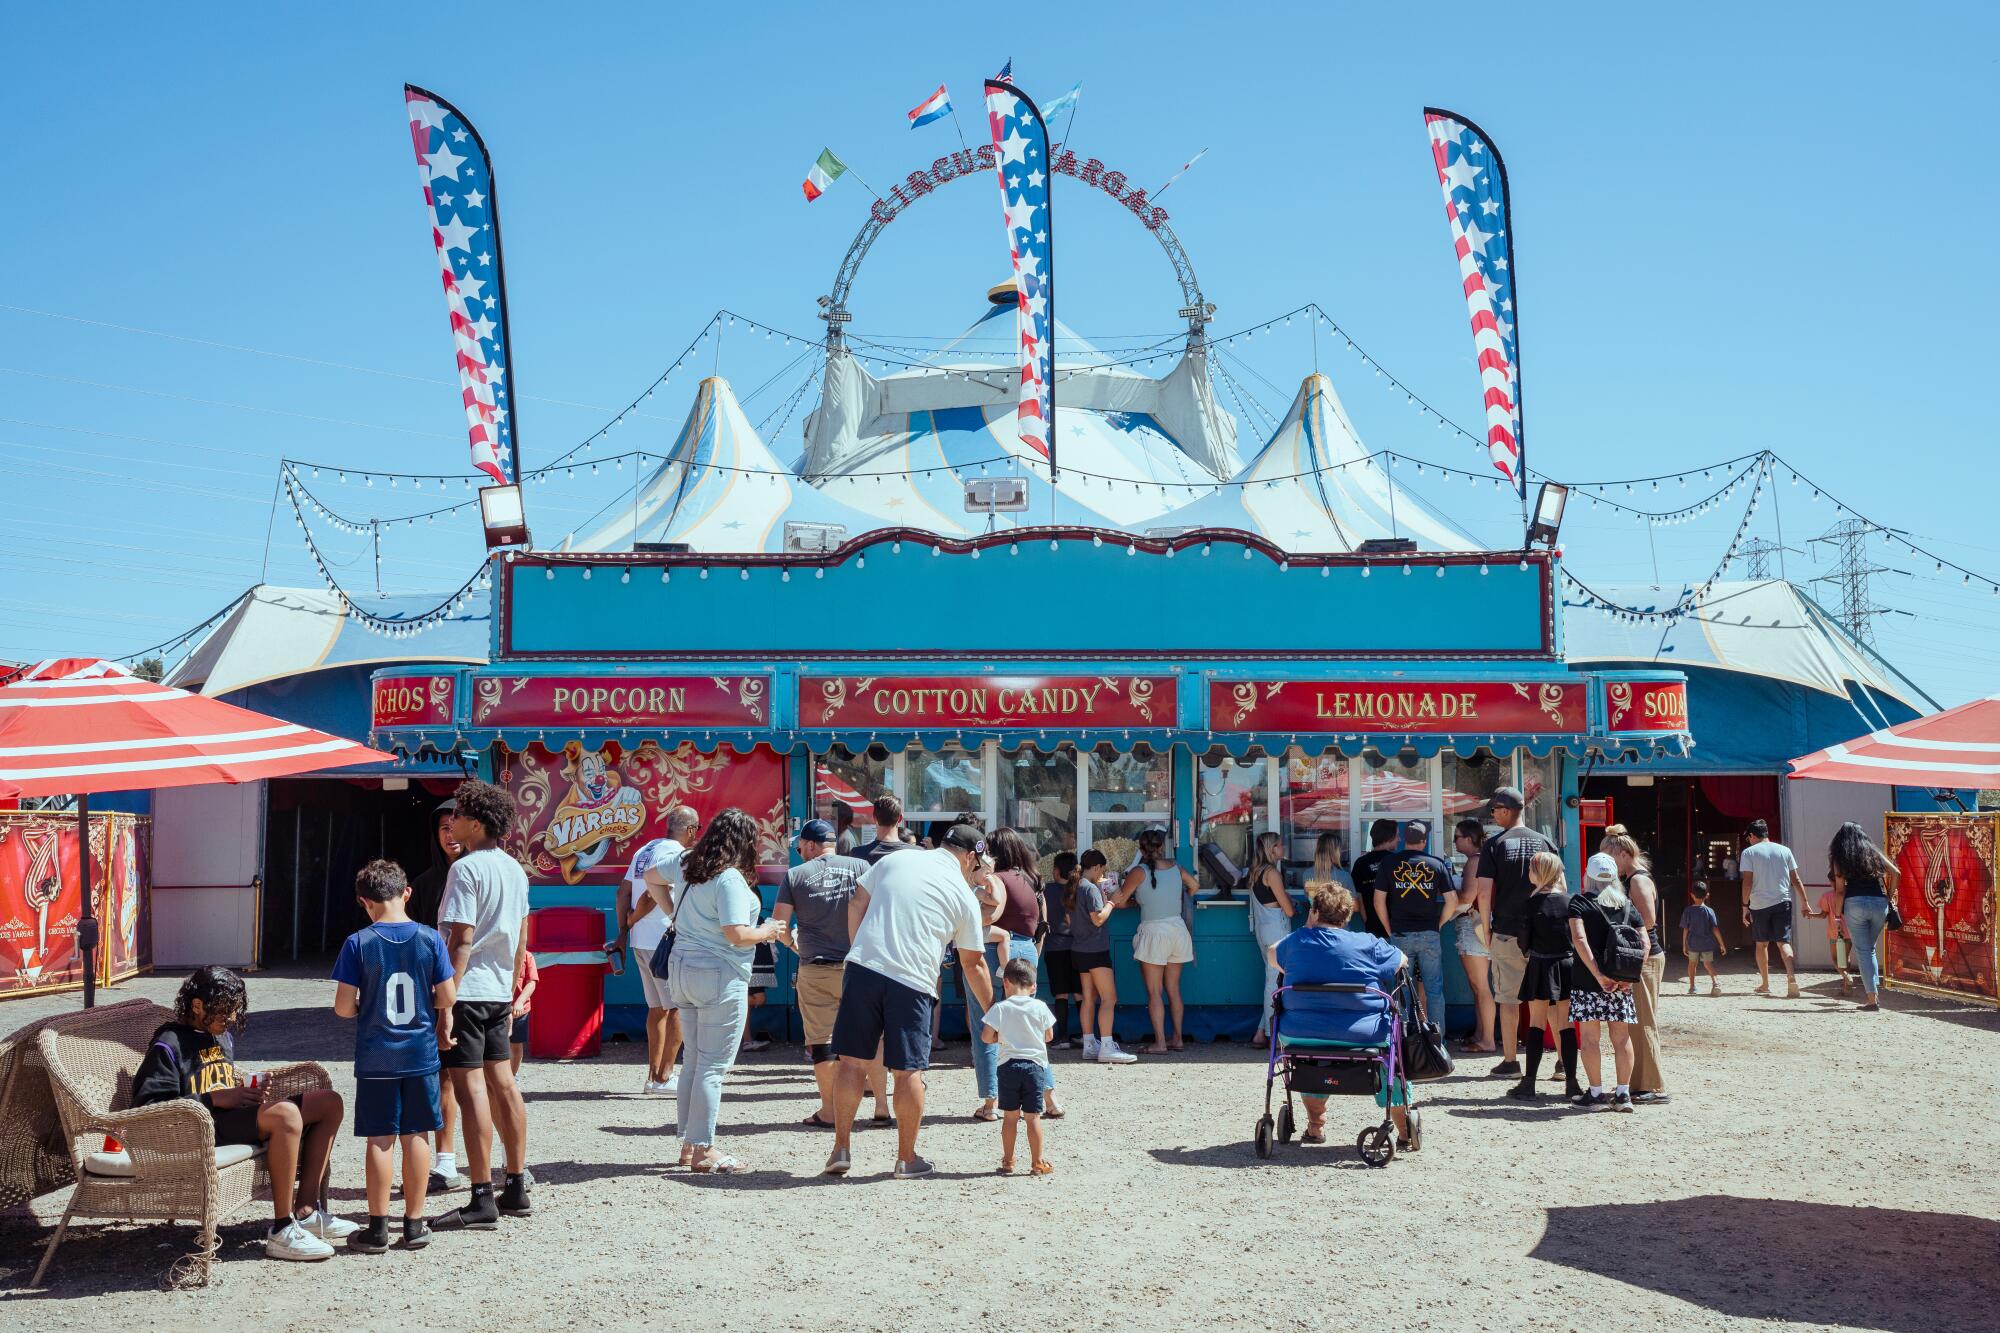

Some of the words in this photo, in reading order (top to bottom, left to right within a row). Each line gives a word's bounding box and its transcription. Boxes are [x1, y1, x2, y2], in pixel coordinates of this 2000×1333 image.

[870, 144, 996, 224] CIRCUS
[553, 687, 686, 713] POPCORN
[873, 688, 987, 715] COTTON
[997, 683, 1102, 714] CANDY
[1315, 692, 1480, 718] LEMONADE
[553, 807, 640, 848] VARGAS
[1395, 881, 1415, 889] KICK
[386, 972, 416, 1026] 0
